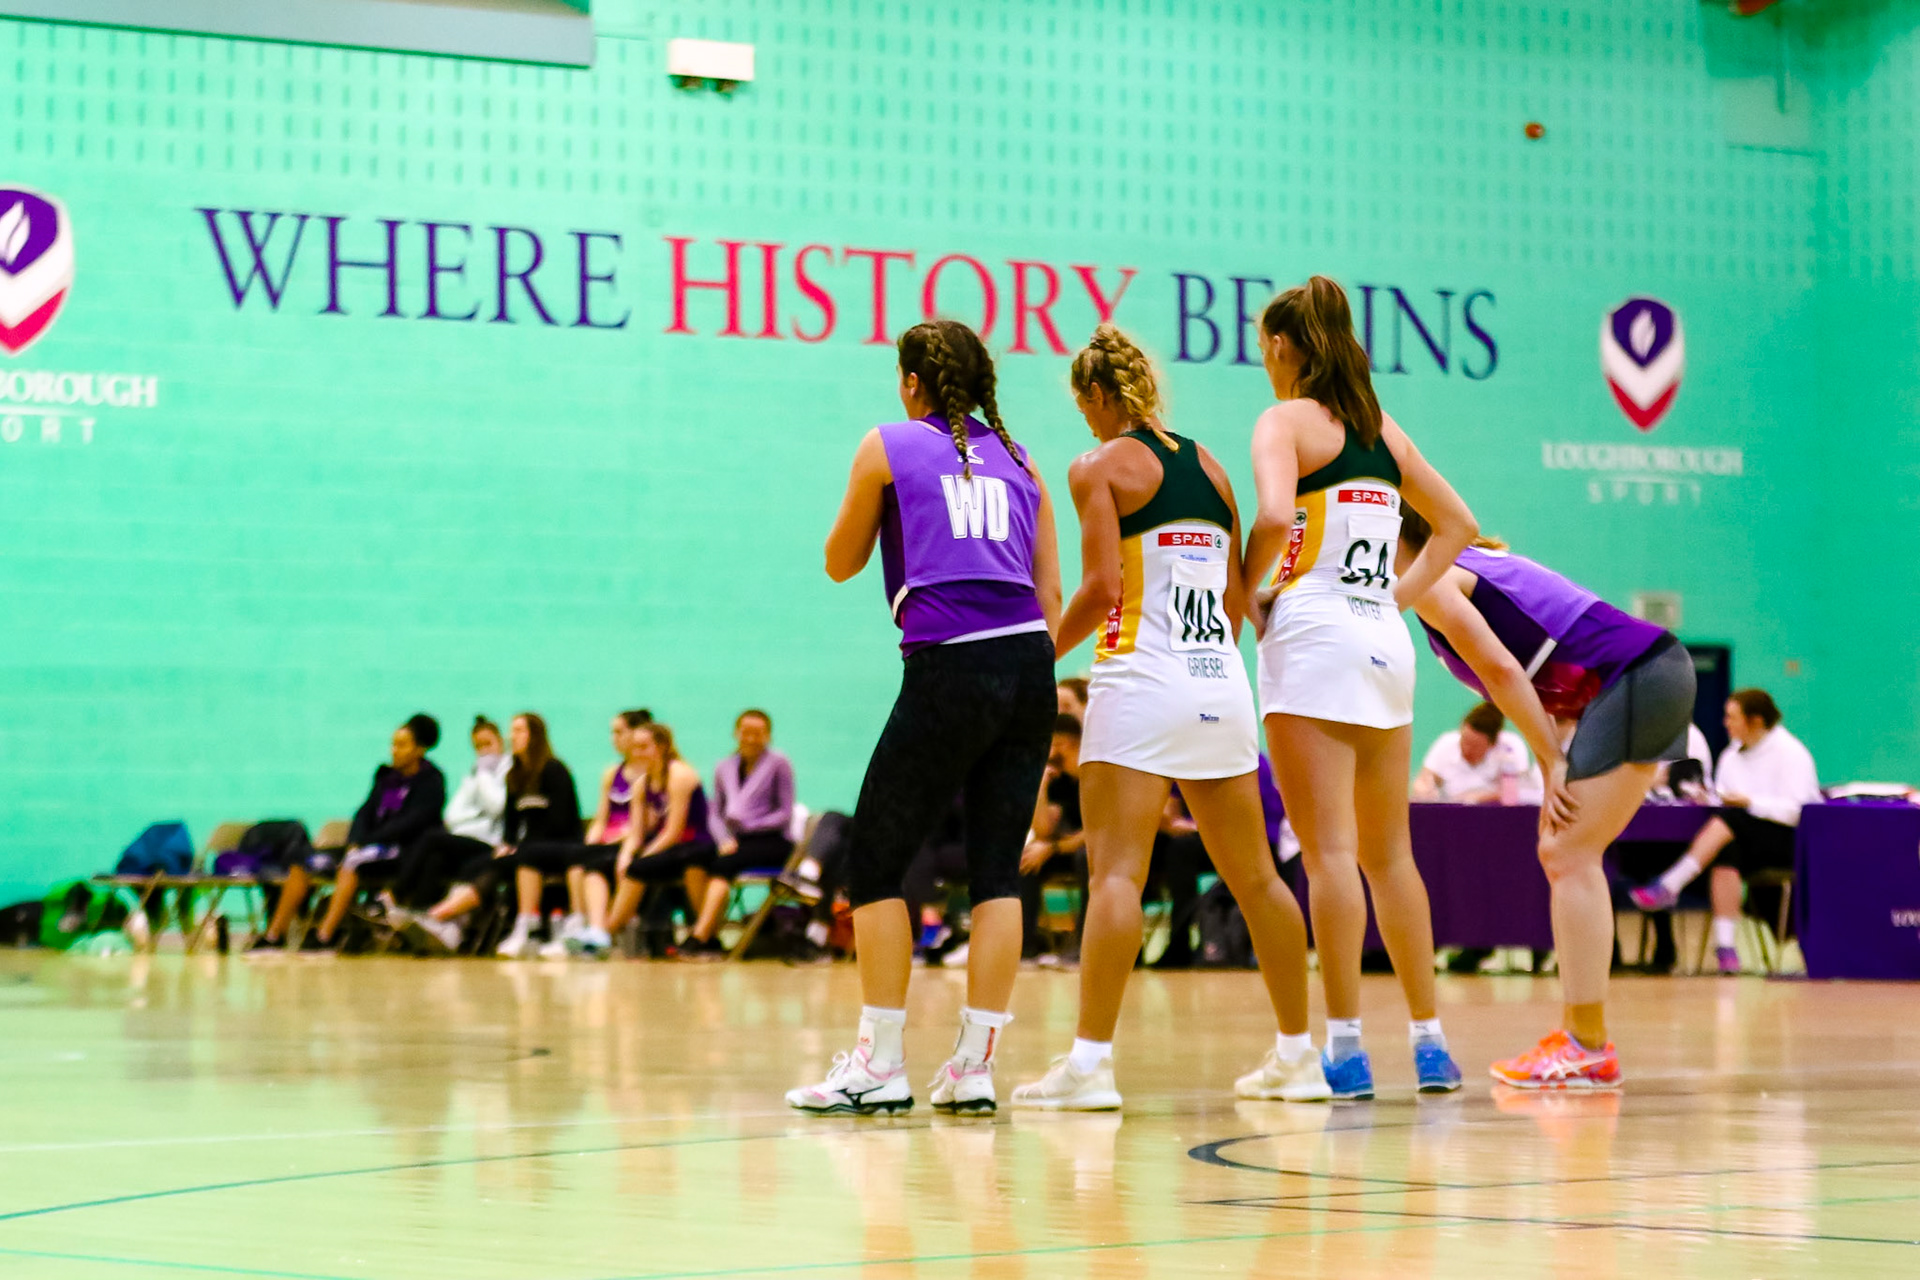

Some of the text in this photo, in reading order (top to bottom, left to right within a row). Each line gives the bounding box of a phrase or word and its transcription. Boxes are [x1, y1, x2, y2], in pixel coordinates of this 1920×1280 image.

[194, 207, 1499, 381] WHERE HISTORY BEINS
[940, 474, 1010, 542] WD
[1351, 491, 1390, 507] SPAR
[1172, 534, 1213, 546] SPAR
[1341, 539, 1390, 590] GA
[1174, 585, 1226, 645] WA
[1347, 596, 1385, 621] VENTER
[1187, 657, 1229, 679] GRIESEL
